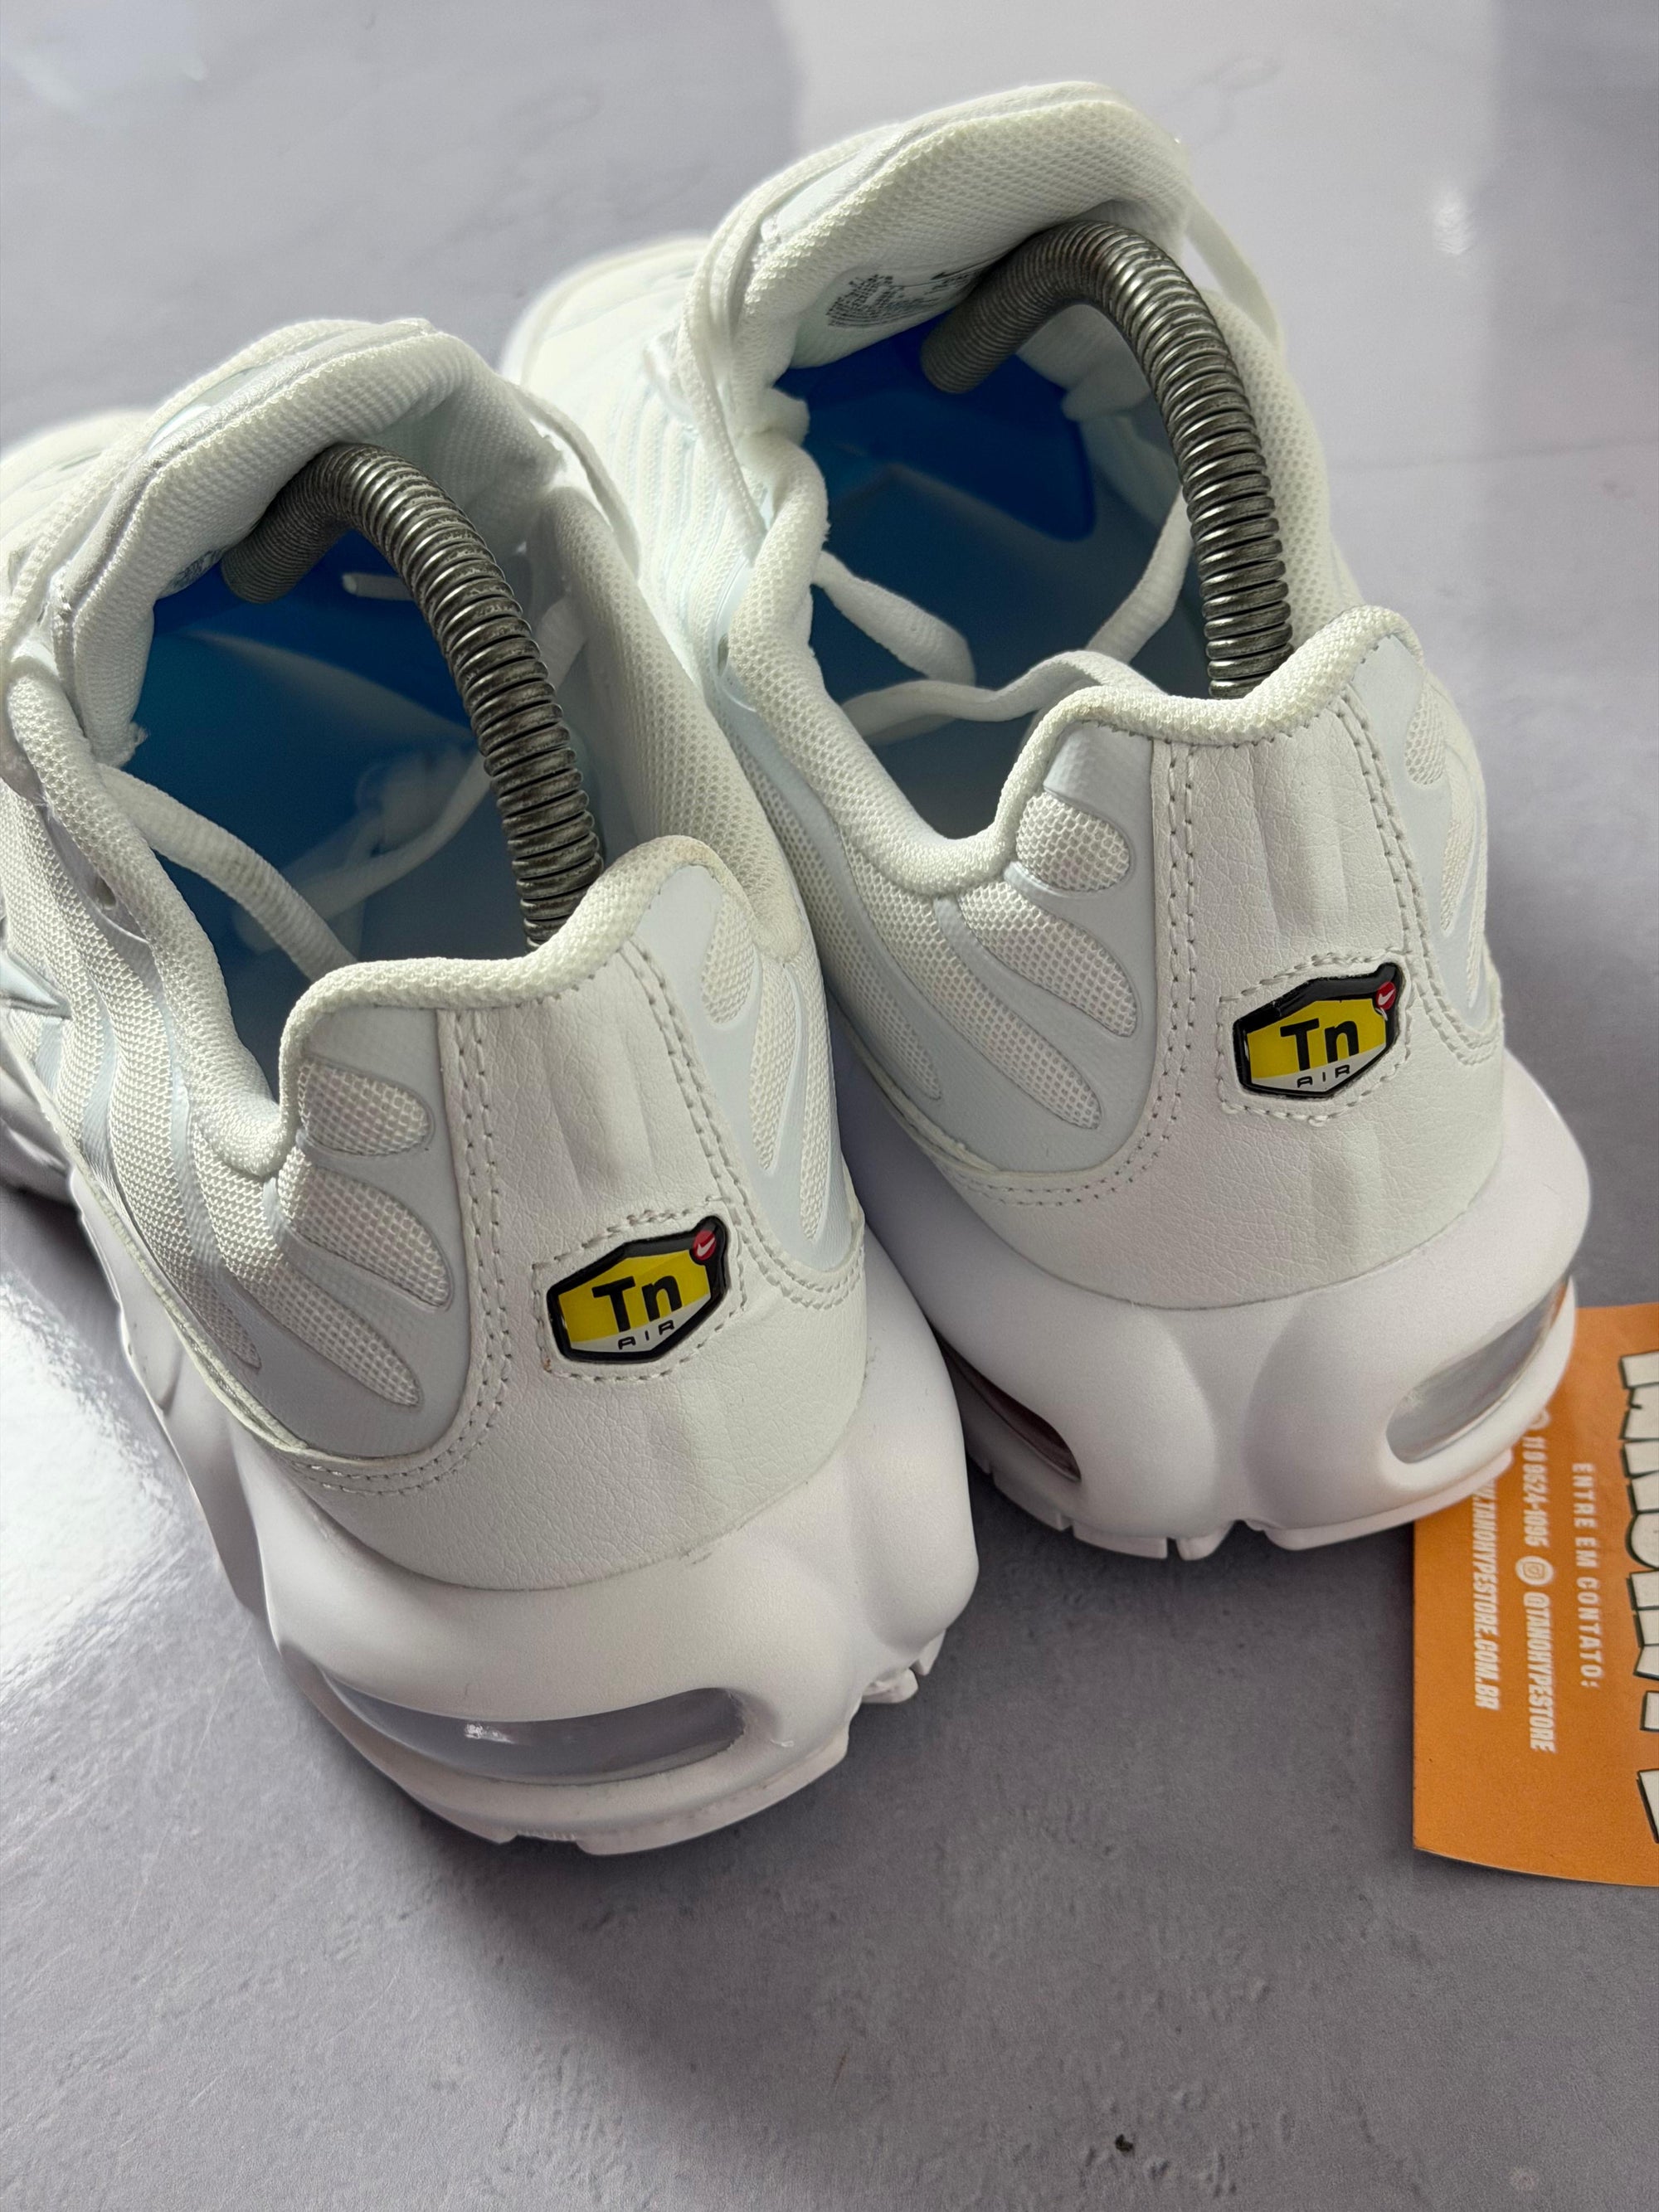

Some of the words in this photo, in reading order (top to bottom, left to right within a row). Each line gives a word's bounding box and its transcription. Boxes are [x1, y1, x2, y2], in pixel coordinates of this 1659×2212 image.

[1280, 1018, 1360, 1071] Tn
[1297, 1065, 1350, 1088] AIR
[591, 1276, 683, 1333] Tn
[618, 1320, 674, 1349] AIR
[1572, 1462, 1596, 1529] ENTRE
[1575, 1537, 1599, 1568] EM
[1577, 1577, 1603, 1688] CONTATO:
[1524, 1592, 1556, 1753] @TANOHYPESTORE
